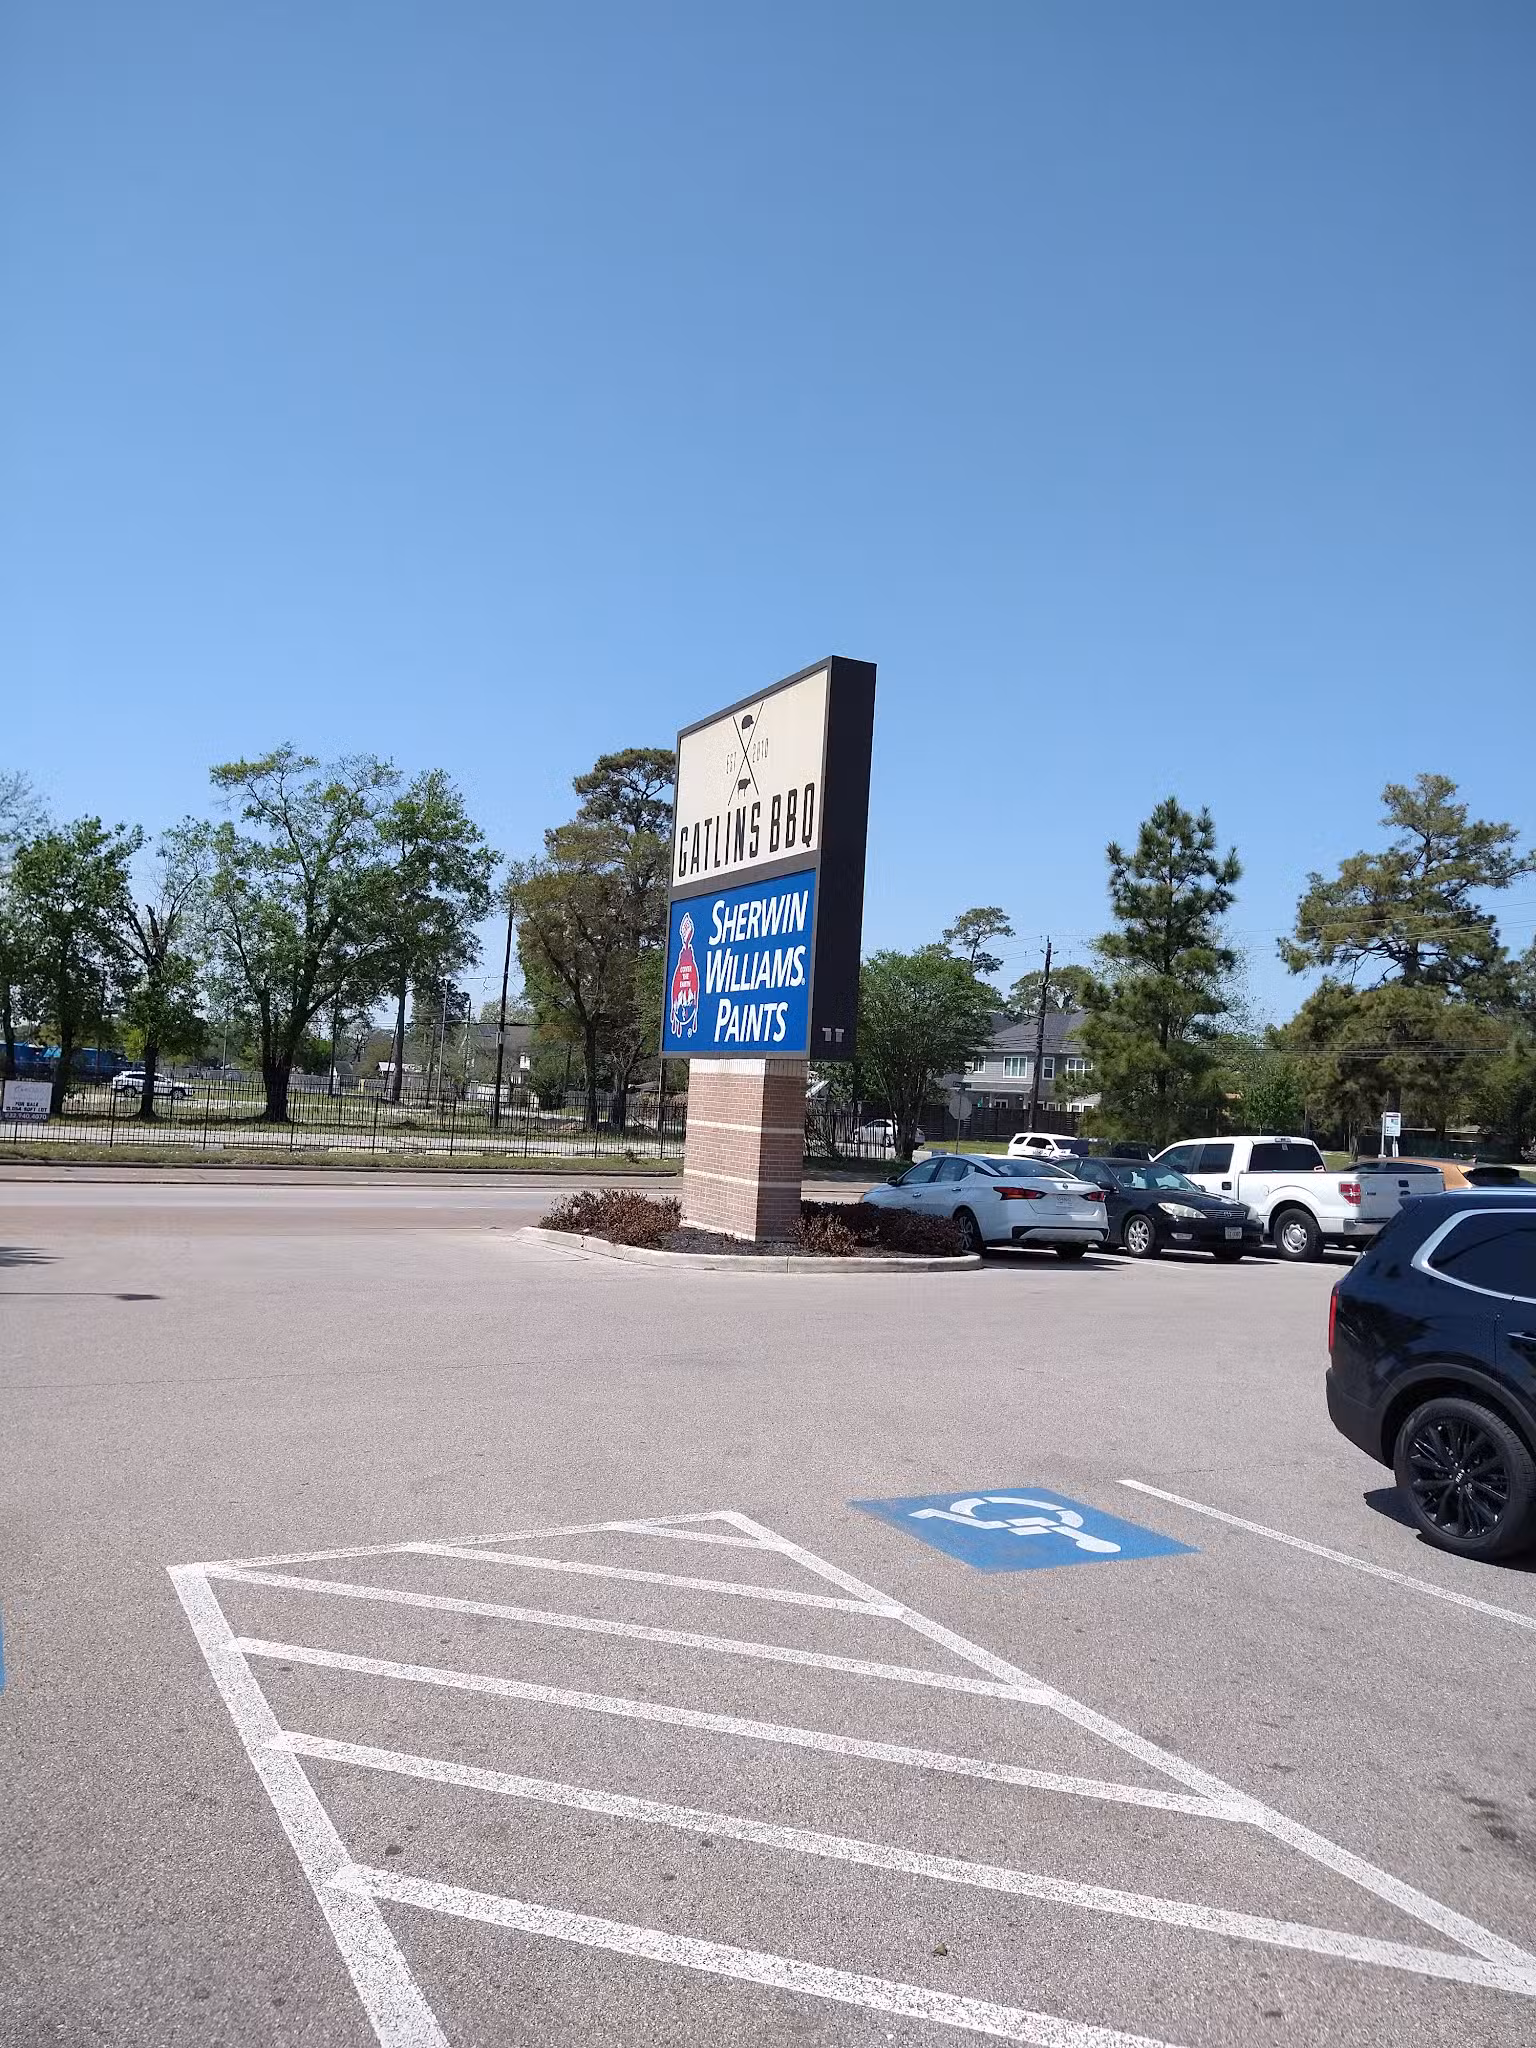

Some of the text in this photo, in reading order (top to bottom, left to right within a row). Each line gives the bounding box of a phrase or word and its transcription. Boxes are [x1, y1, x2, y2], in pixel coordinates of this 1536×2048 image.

[726, 738, 769, 775] EST 2010
[678, 782, 815, 878] GATLINS BBQ
[709, 890, 809, 946] SHERWIN
[705, 945, 806, 994] WILLIAMS
[714, 998, 788, 1043] PAINTS
